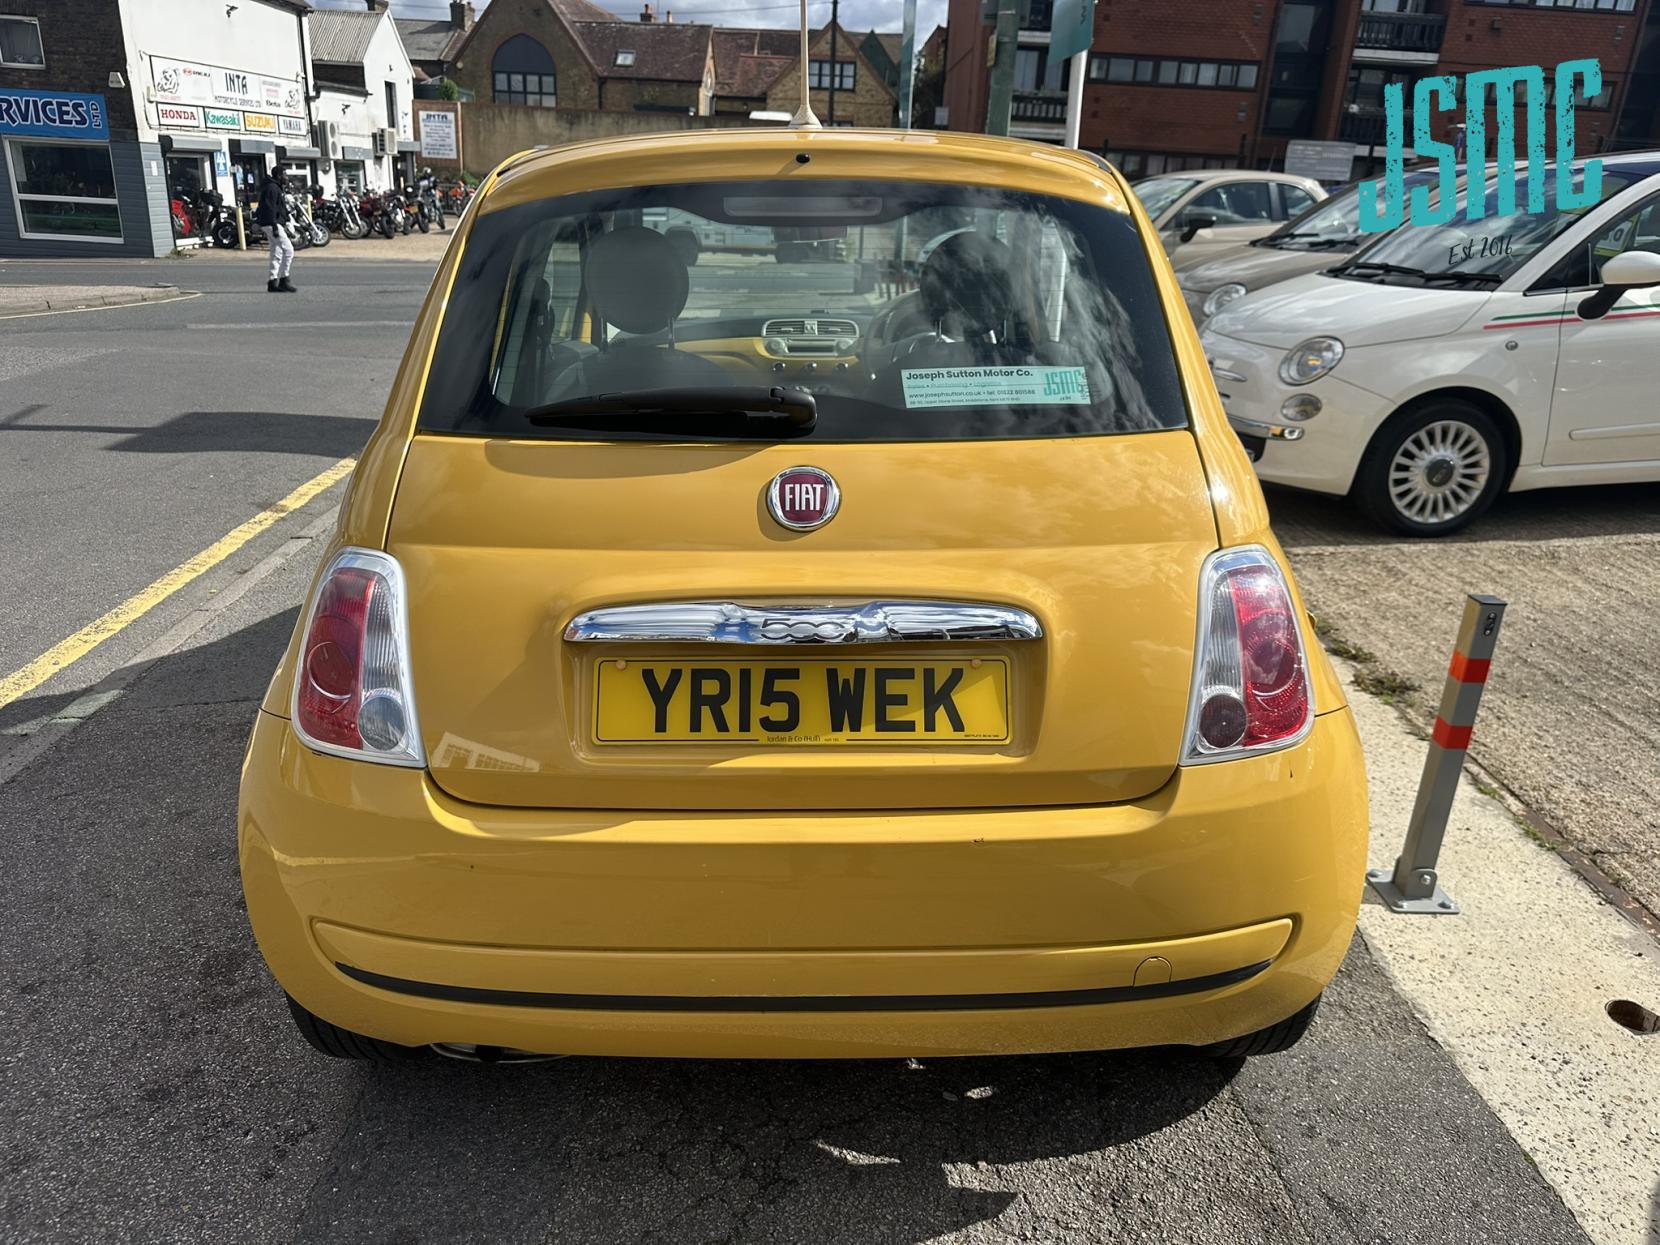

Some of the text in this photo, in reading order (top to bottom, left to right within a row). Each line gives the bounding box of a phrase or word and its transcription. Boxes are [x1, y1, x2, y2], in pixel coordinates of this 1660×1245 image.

[225, 73, 248, 95] INTA
[90, 101, 102, 128] LTD
[160, 109, 196, 120] HONDA
[205, 111, 239, 126] Kawasaki
[246, 115, 275, 129] SUZUKI
[1449, 234, 1512, 265] Est 2016
[906, 369, 1033, 381] Joseph Sutton Motor Co.
[785, 483, 824, 511] FIAT
[761, 618, 845, 640] 500
[642, 668, 965, 732] YR15 WEK
